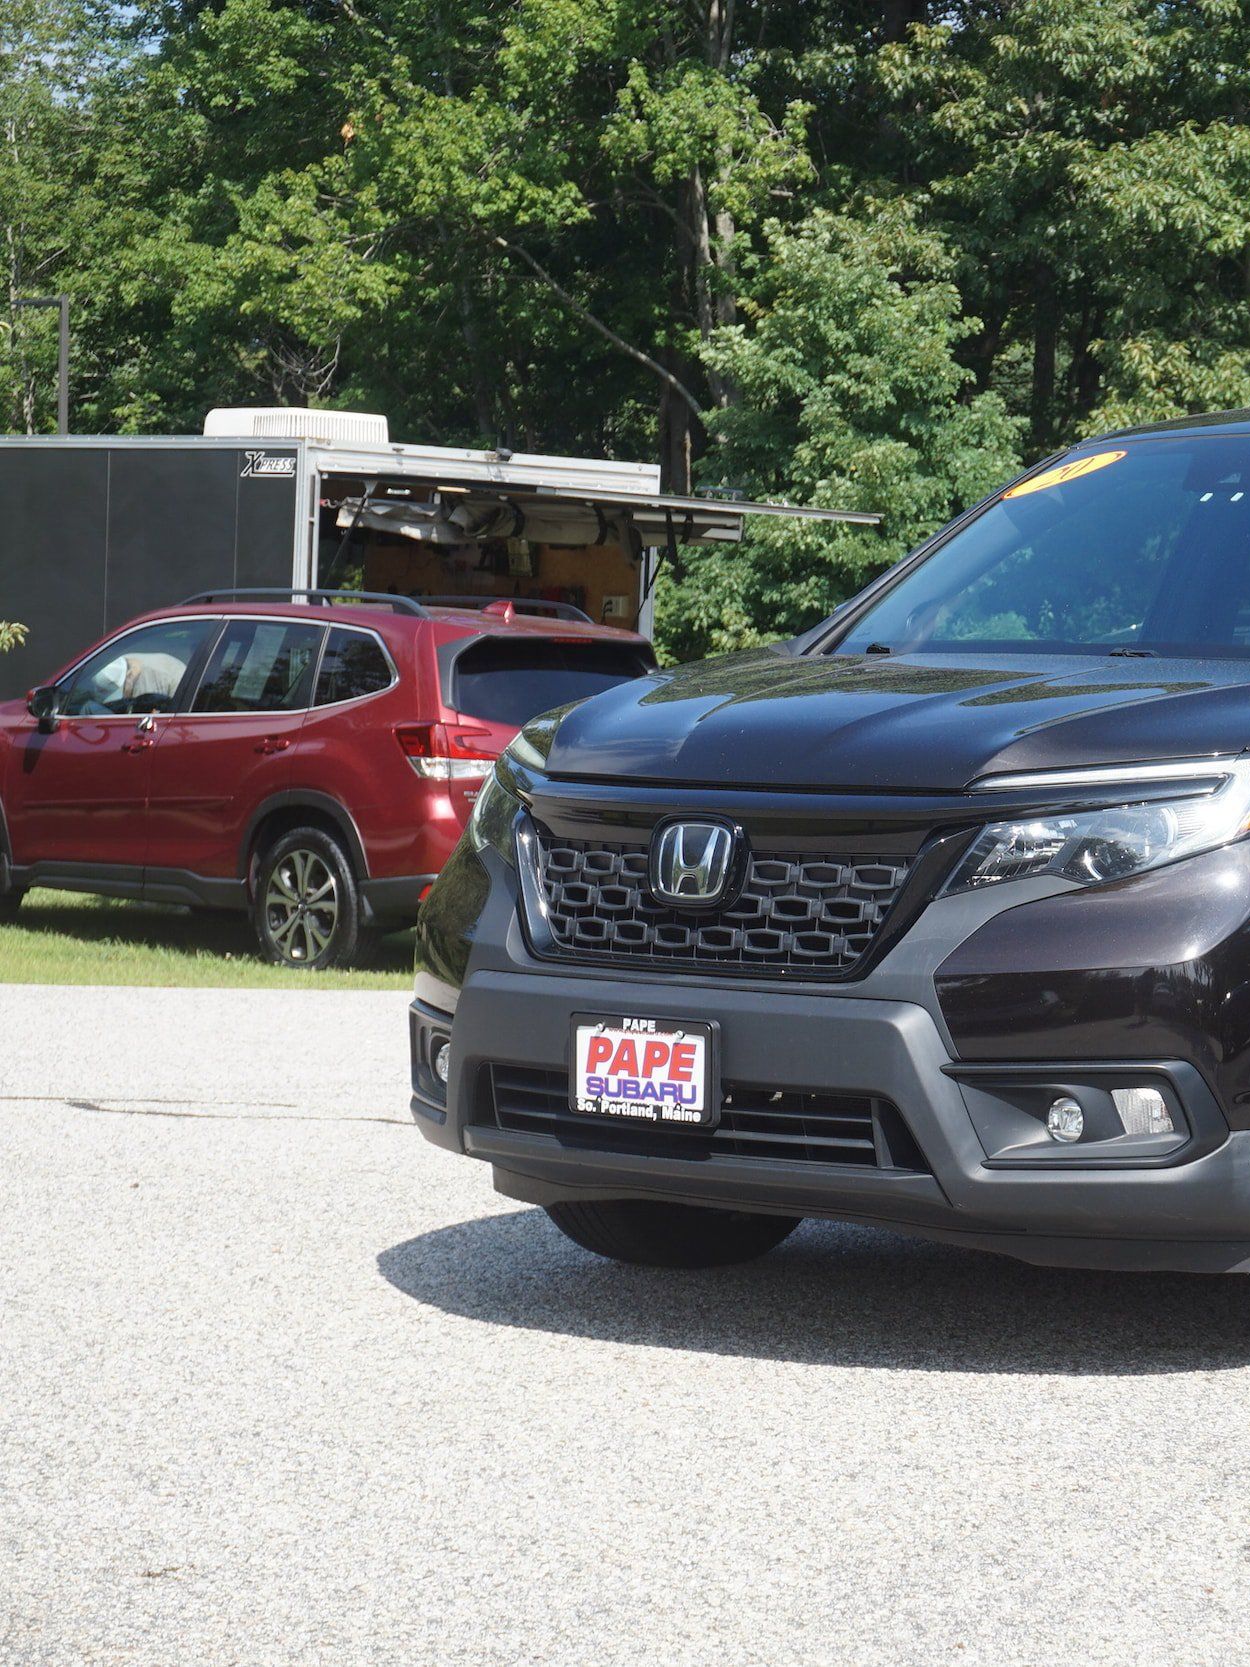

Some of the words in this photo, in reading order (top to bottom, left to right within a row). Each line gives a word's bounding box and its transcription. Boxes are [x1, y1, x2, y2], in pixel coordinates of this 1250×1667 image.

[622, 1018, 656, 1032] PAPE
[586, 1036, 697, 1082] PAPE
[586, 1076, 697, 1105] SUBARU
[577, 1100, 597, 1113] So.
[600, 1100, 657, 1121] Portland,
[661, 1105, 701, 1123] Maine
